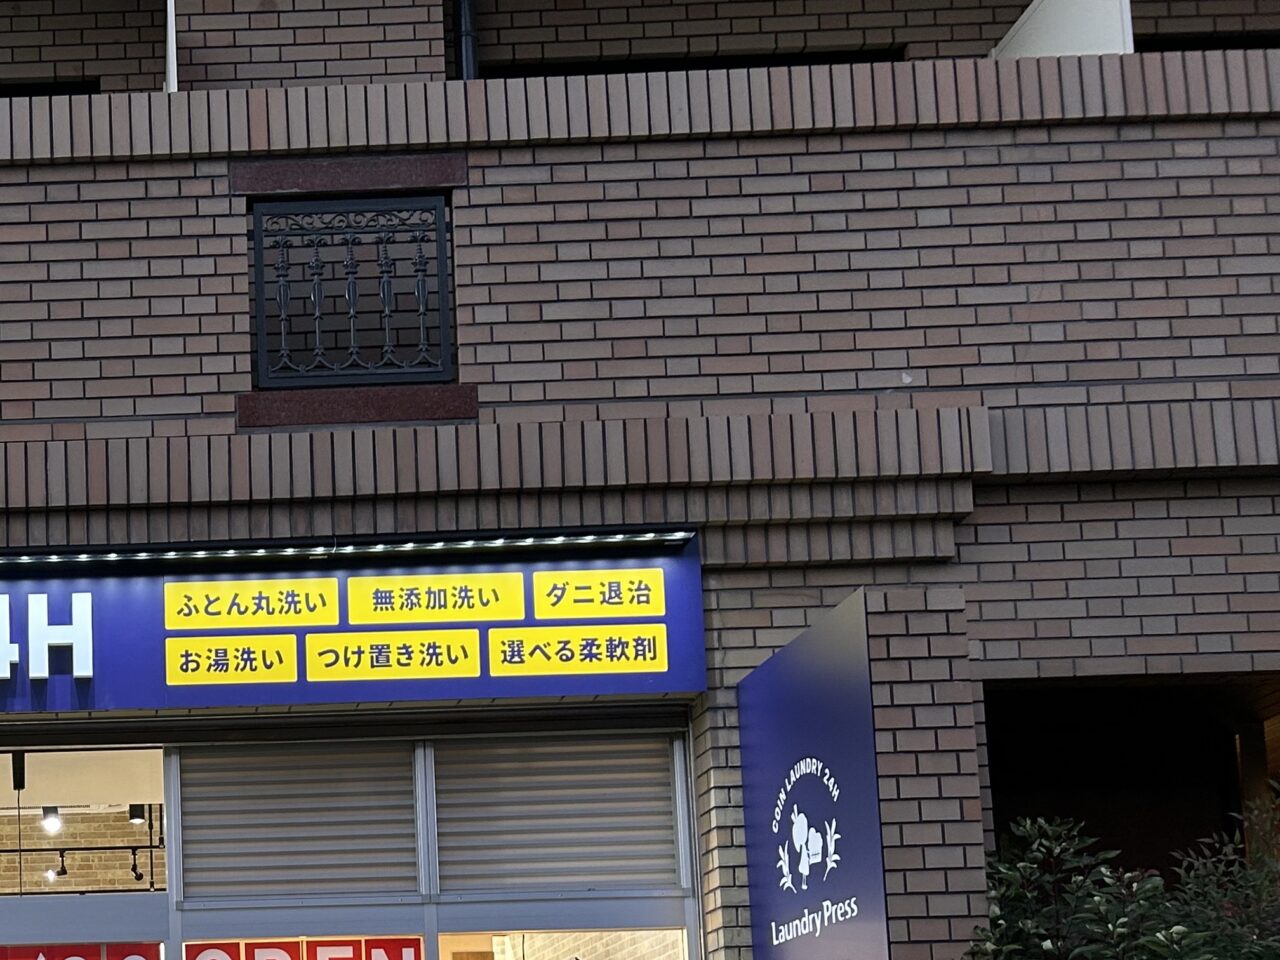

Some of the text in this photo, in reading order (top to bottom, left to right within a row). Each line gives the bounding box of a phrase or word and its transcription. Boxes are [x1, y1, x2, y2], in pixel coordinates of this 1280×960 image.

[176, 589, 327, 617] ふとん丸洗い
[372, 585, 500, 612] 無添加洗い
[545, 580, 652, 607] ダニ退治
[179, 647, 284, 674] お湯洗い
[317, 641, 469, 669] つけ置き洗い
[500, 635, 658, 664] 選べる柔軟剤
[772, 757, 840, 833] COIN LAUNDRY 24H
[771, 896, 858, 946] Laundry Press
